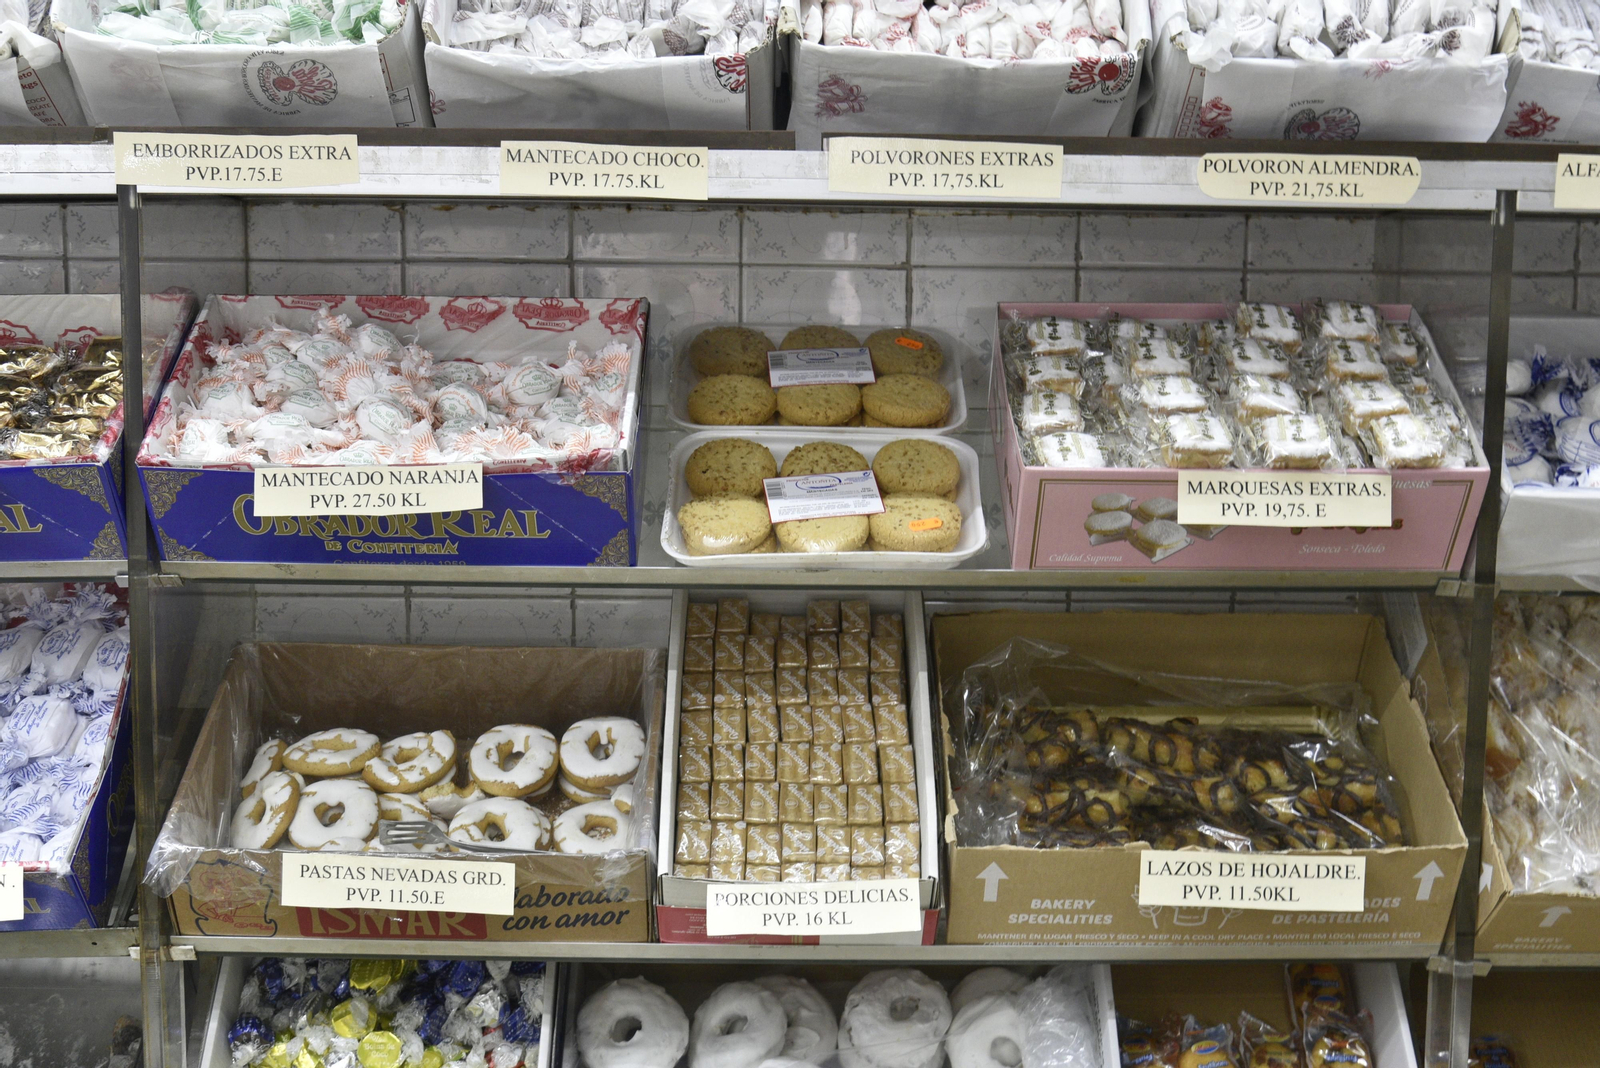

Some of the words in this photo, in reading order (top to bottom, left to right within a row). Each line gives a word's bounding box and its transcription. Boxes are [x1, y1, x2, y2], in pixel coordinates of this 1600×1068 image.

[18, 71, 33, 80] eto
[133, 143, 283, 160] EMBORRIZADOS
[289, 145, 352, 161] EXTRA
[506, 148, 629, 167] MANTECADO
[633, 151, 704, 168] CHOCO.
[850, 149, 975, 167] POLVORONES
[980, 151, 1054, 168] EXTRAS
[185, 167, 283, 183] PVP.17.75.E
[1203, 158, 1304, 176] POLVORON
[1309, 160, 1420, 178] ALMENDRA.
[549, 172, 586, 188] PVP.
[593, 173, 665, 190] 17.75.KL
[888, 172, 925, 188] PVP.
[932, 173, 1004, 191] 17,75.KL
[1249, 181, 1286, 197] PVP.
[1291, 182, 1364, 199] 21,75.KL
[261, 470, 384, 488] MANTECADO
[389, 469, 480, 485] NARANJA
[1392, 480, 1432, 489] uesas
[1187, 480, 1305, 498] MARQUESAS
[1309, 481, 1387, 497] EXTRAS.
[310, 494, 348, 509] PVP.
[352, 493, 396, 508] 27.50
[401, 493, 427, 507] KL
[1221, 503, 1259, 518] PVP.
[1263, 502, 1310, 520] 19,75.
[1315, 503, 1327, 518] E
[432, 508, 551, 539] REAL
[1049, 552, 1084, 562] Calidad
[1084, 553, 1123, 565] Suprema
[300, 864, 366, 881] PASTAS
[371, 866, 457, 885] NEVADAS
[462, 870, 506, 886] GRD.
[1147, 860, 1212, 878] LAZOS
[1219, 862, 1246, 878] DE
[1251, 862, 1362, 881] HOJALDRE.
[346, 887, 383, 902] PVP.
[389, 889, 445, 905] 11.50.E
[514, 885, 630, 909] laborado
[715, 891, 819, 907] PORCIONES
[824, 888, 914, 904] DELICIAS.
[1182, 884, 1221, 900] PVP.
[1230, 885, 1301, 902] 11.50KL
[1030, 899, 1096, 910] BAKERY
[502, 912, 549, 932] con
[555, 908, 630, 929] amor
[762, 911, 798, 927] PVP.
[805, 911, 823, 926] 16
[828, 911, 853, 925] KL
[1008, 913, 1113, 925] SPECIALITIES
[1272, 913, 1293, 925] DE
[1296, 909, 1390, 925] PASTELERÍA
